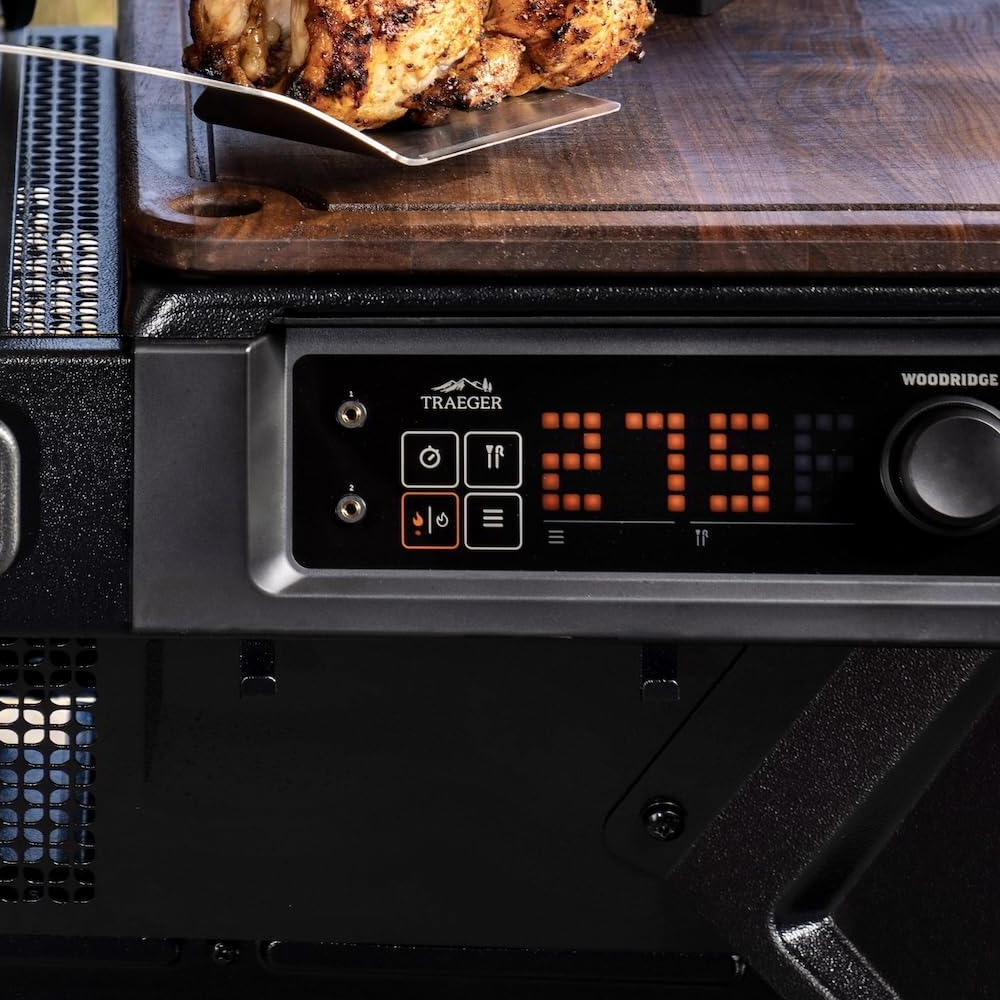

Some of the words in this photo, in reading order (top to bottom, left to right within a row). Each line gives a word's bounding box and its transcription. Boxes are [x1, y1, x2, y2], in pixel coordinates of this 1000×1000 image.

[901, 372, 999, 386] WOODRIDGE
[420, 395, 503, 410] TRAEGER
[542, 412, 770, 512] 275
[349, 483, 354, 492] 2
